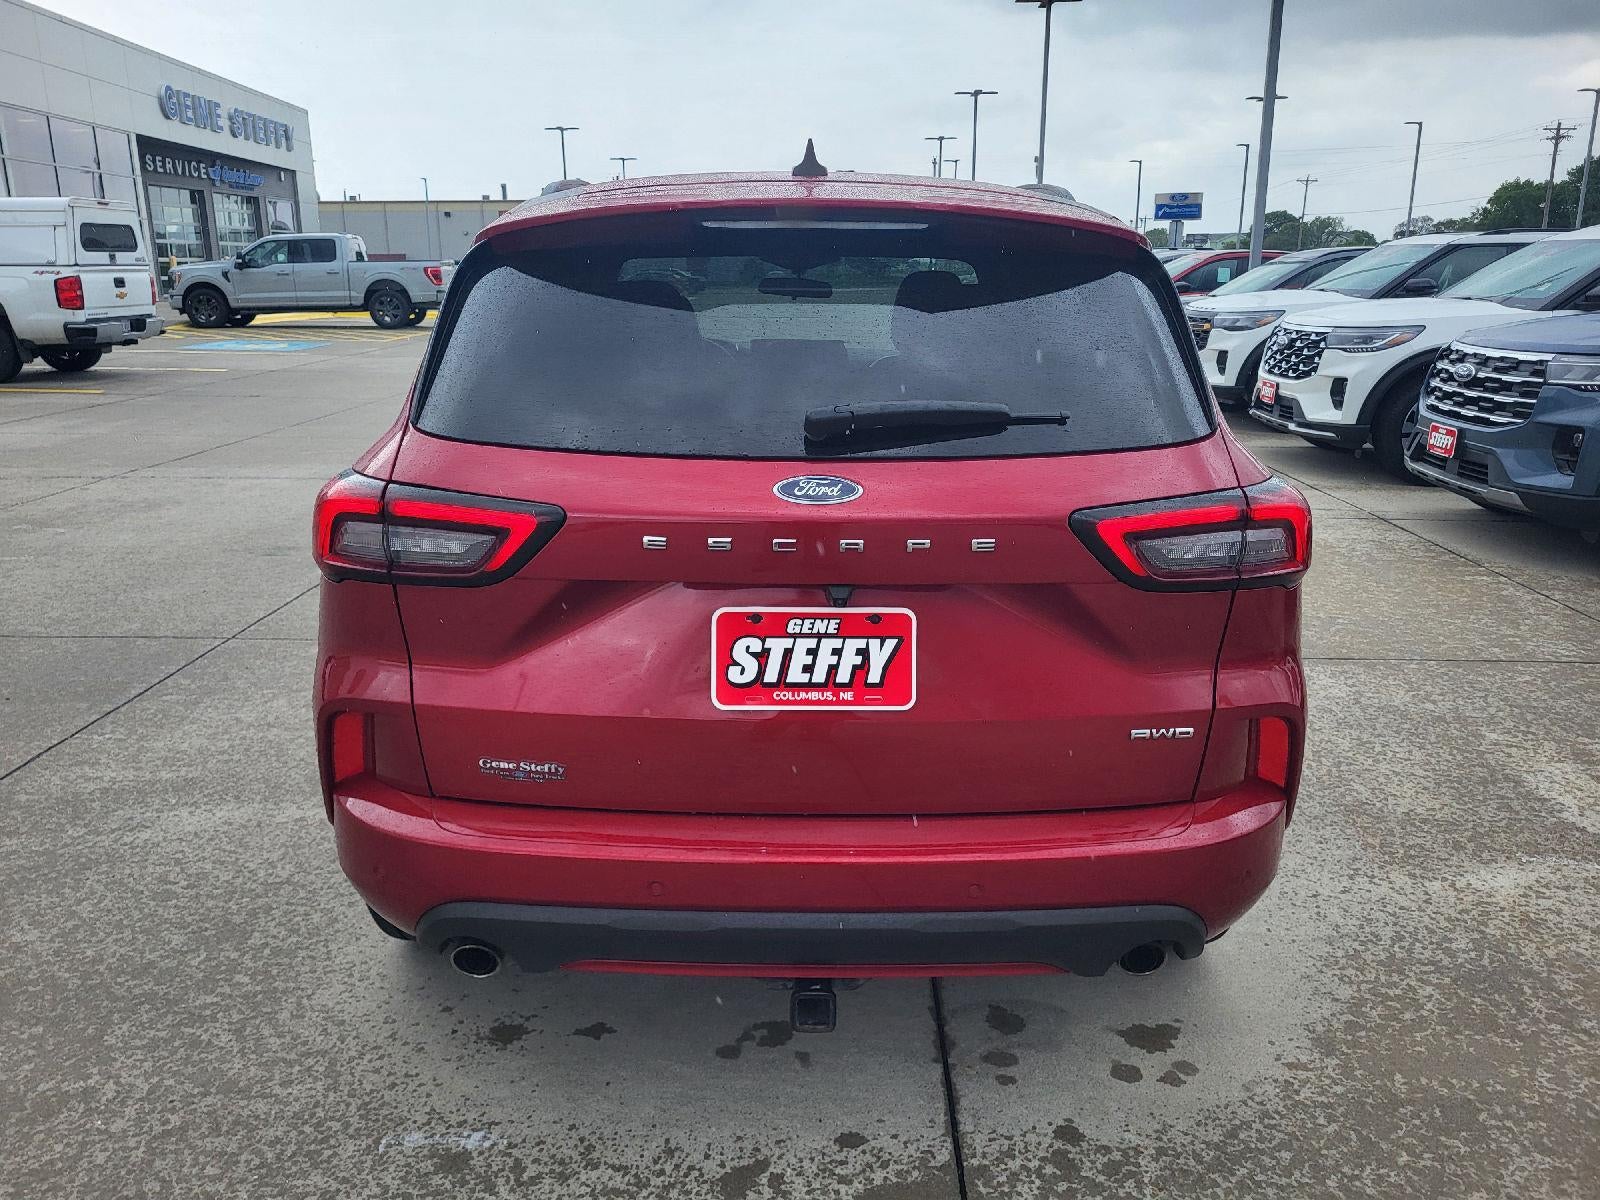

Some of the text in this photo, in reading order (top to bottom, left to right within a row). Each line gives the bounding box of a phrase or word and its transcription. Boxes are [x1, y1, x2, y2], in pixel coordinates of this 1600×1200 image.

[158, 83, 294, 152] GENE STEFFY
[145, 154, 208, 179] SERVICE
[1430, 432, 1453, 450] STEFFY
[794, 479, 843, 496] Ford
[642, 535, 996, 552] ESCAPE
[786, 618, 841, 635] GENE
[727, 636, 903, 688] STEFFY
[773, 691, 855, 702] COLUMBUS, NE
[1130, 727, 1195, 741] AWD
[478, 758, 517, 770] Gene
[519, 761, 565, 774] Steffy
